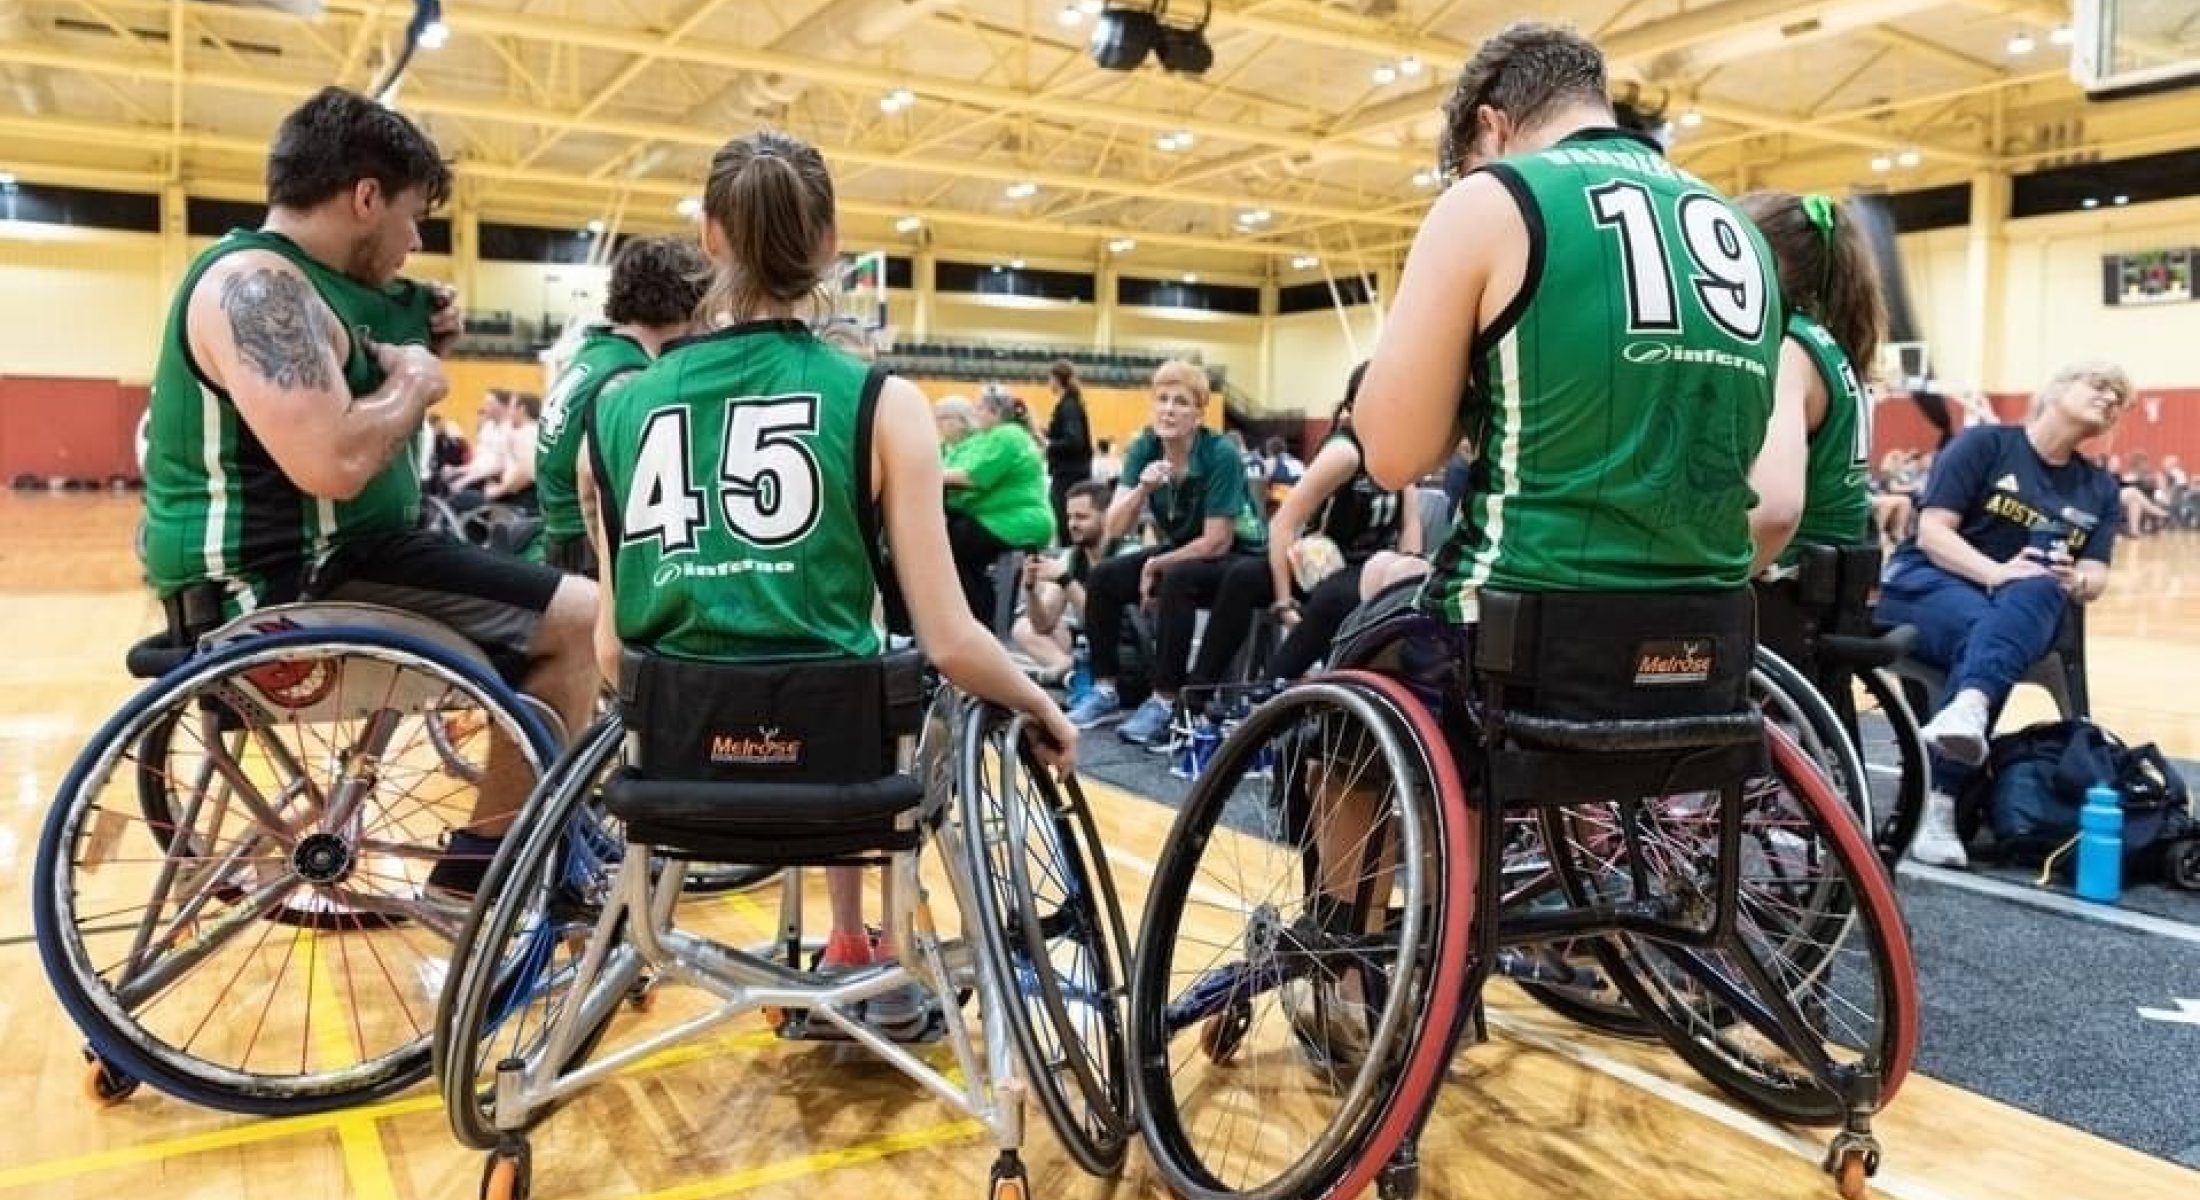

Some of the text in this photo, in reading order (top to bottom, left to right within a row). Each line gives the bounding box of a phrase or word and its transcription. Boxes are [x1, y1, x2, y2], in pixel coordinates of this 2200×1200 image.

[1585, 178, 1769, 345] 19
[621, 393, 824, 560] 45
[712, 736, 802, 755] Melrose
